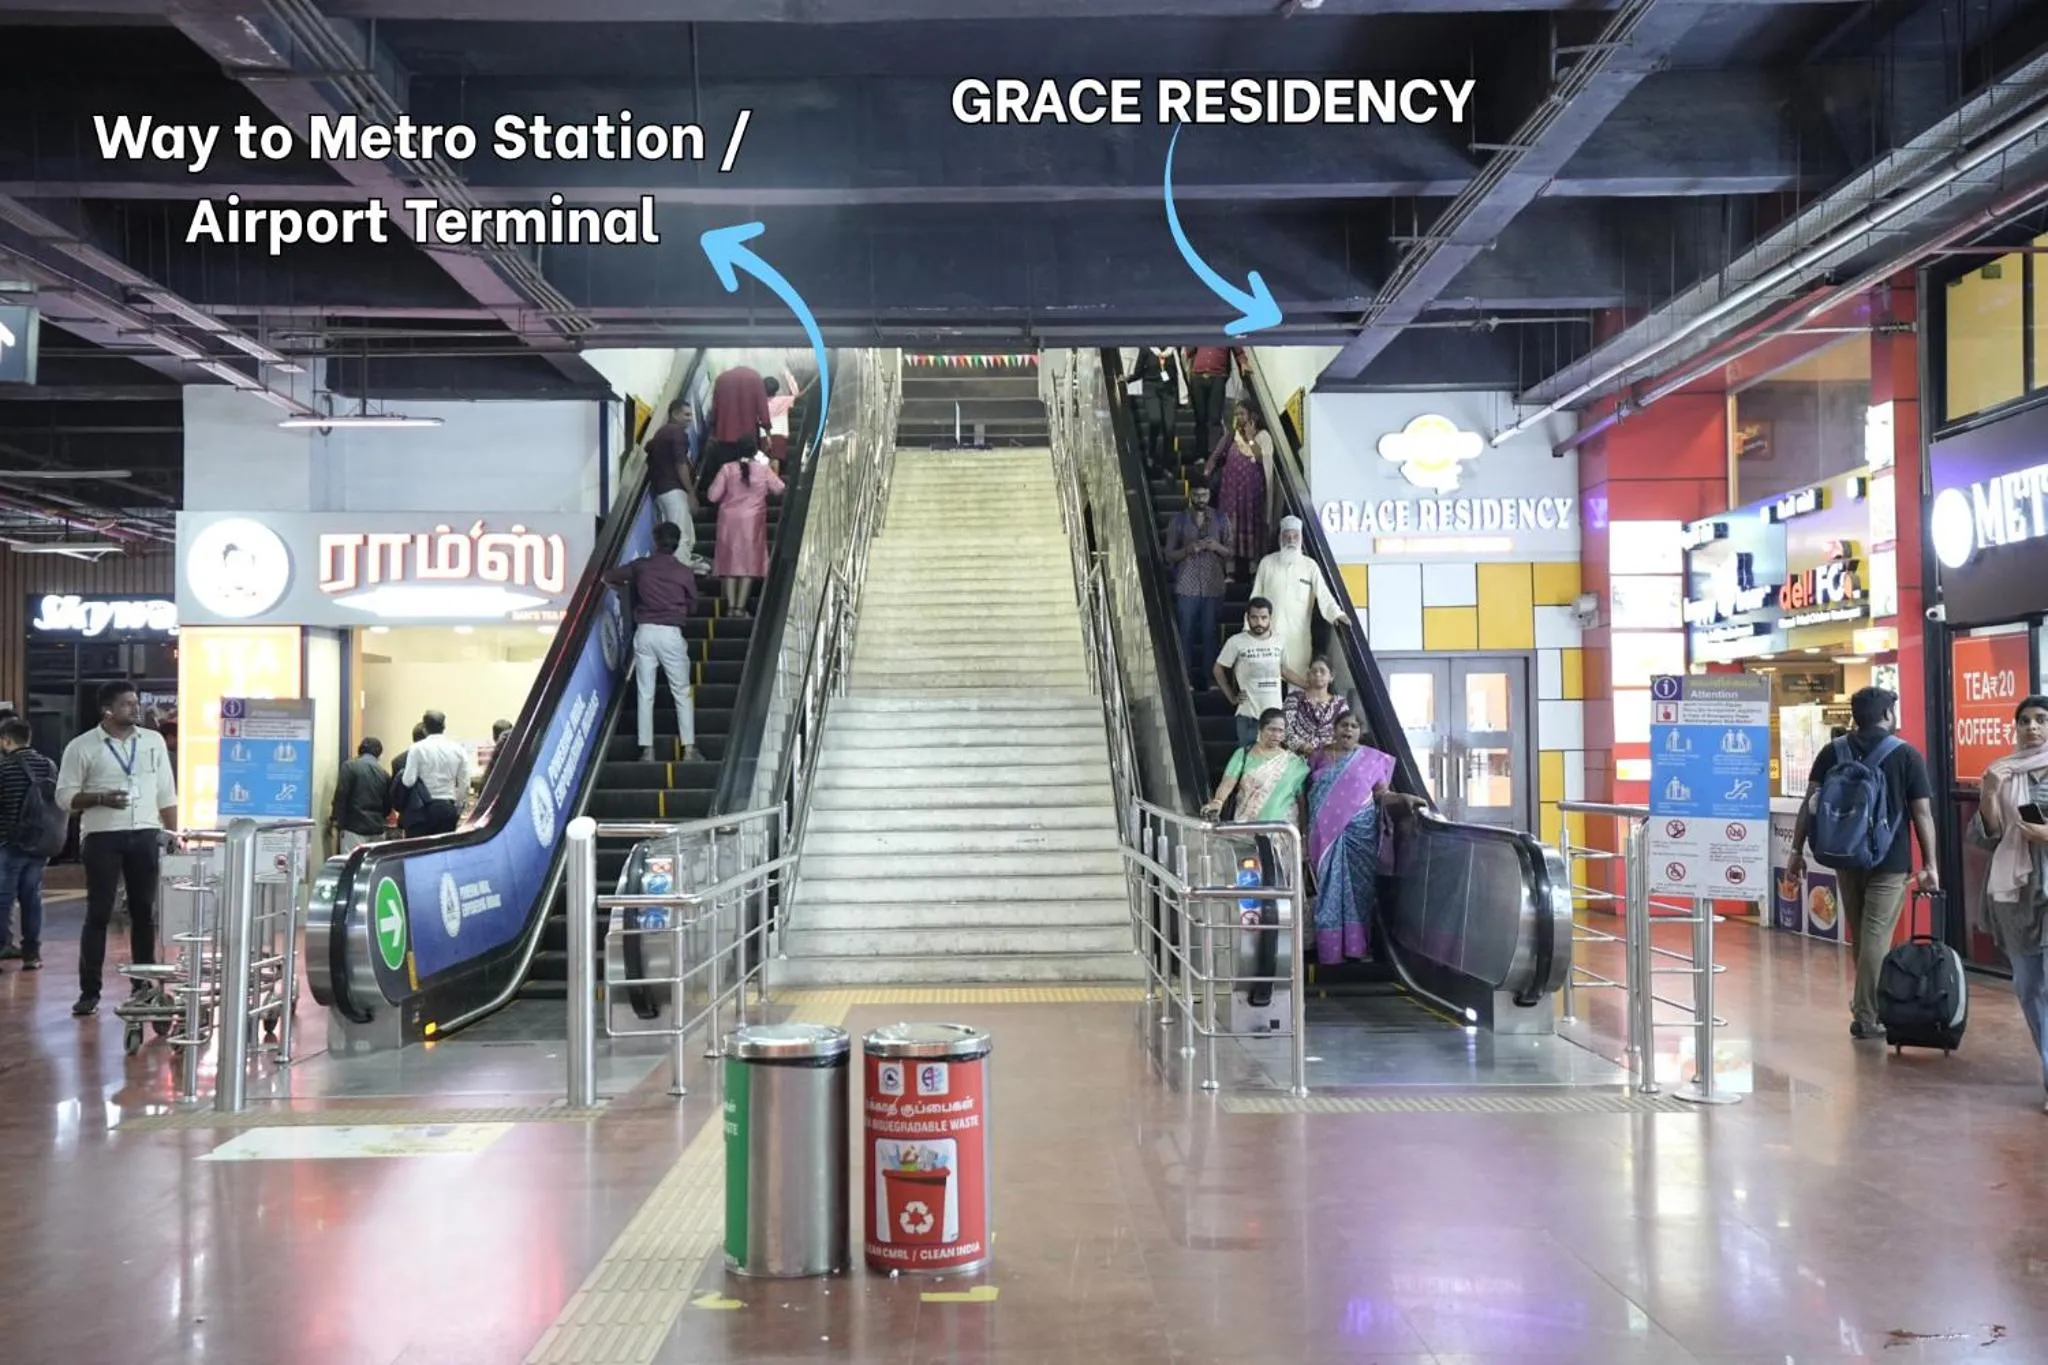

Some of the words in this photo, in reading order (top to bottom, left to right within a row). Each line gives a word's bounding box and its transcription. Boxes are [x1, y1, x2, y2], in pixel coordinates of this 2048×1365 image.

[1322, 500, 1409, 533] GRACE
[1417, 498, 1572, 530] RESIDENCY
[33, 594, 180, 636] Skywa
[1690, 689, 1739, 699] Attention
[1963, 671, 1992, 701] TEA
[1957, 717, 2001, 746] COFFEE
[950, 1114, 979, 1130] WASTE
[883, 1246, 909, 1260] CMRL
[920, 1247, 955, 1260] CLEAN
[956, 1240, 980, 1257] INDIA
